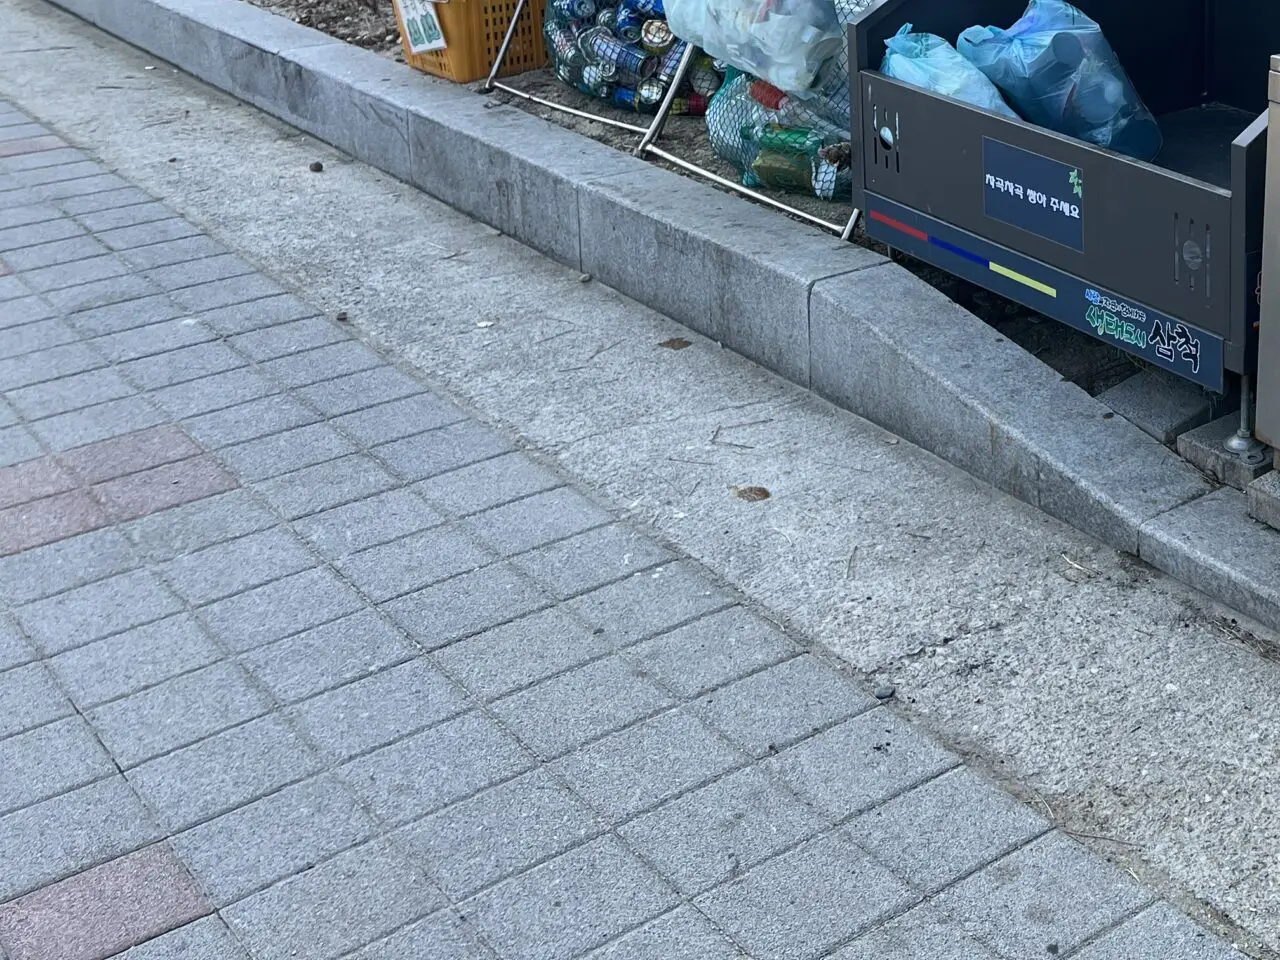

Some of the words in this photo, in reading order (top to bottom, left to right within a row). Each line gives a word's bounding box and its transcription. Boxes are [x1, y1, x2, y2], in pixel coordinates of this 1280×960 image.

[985, 173, 1024, 200] 차곡차곡
[1050, 197, 1080, 219] 주세요
[1147, 319, 1200, 374] 삼척
